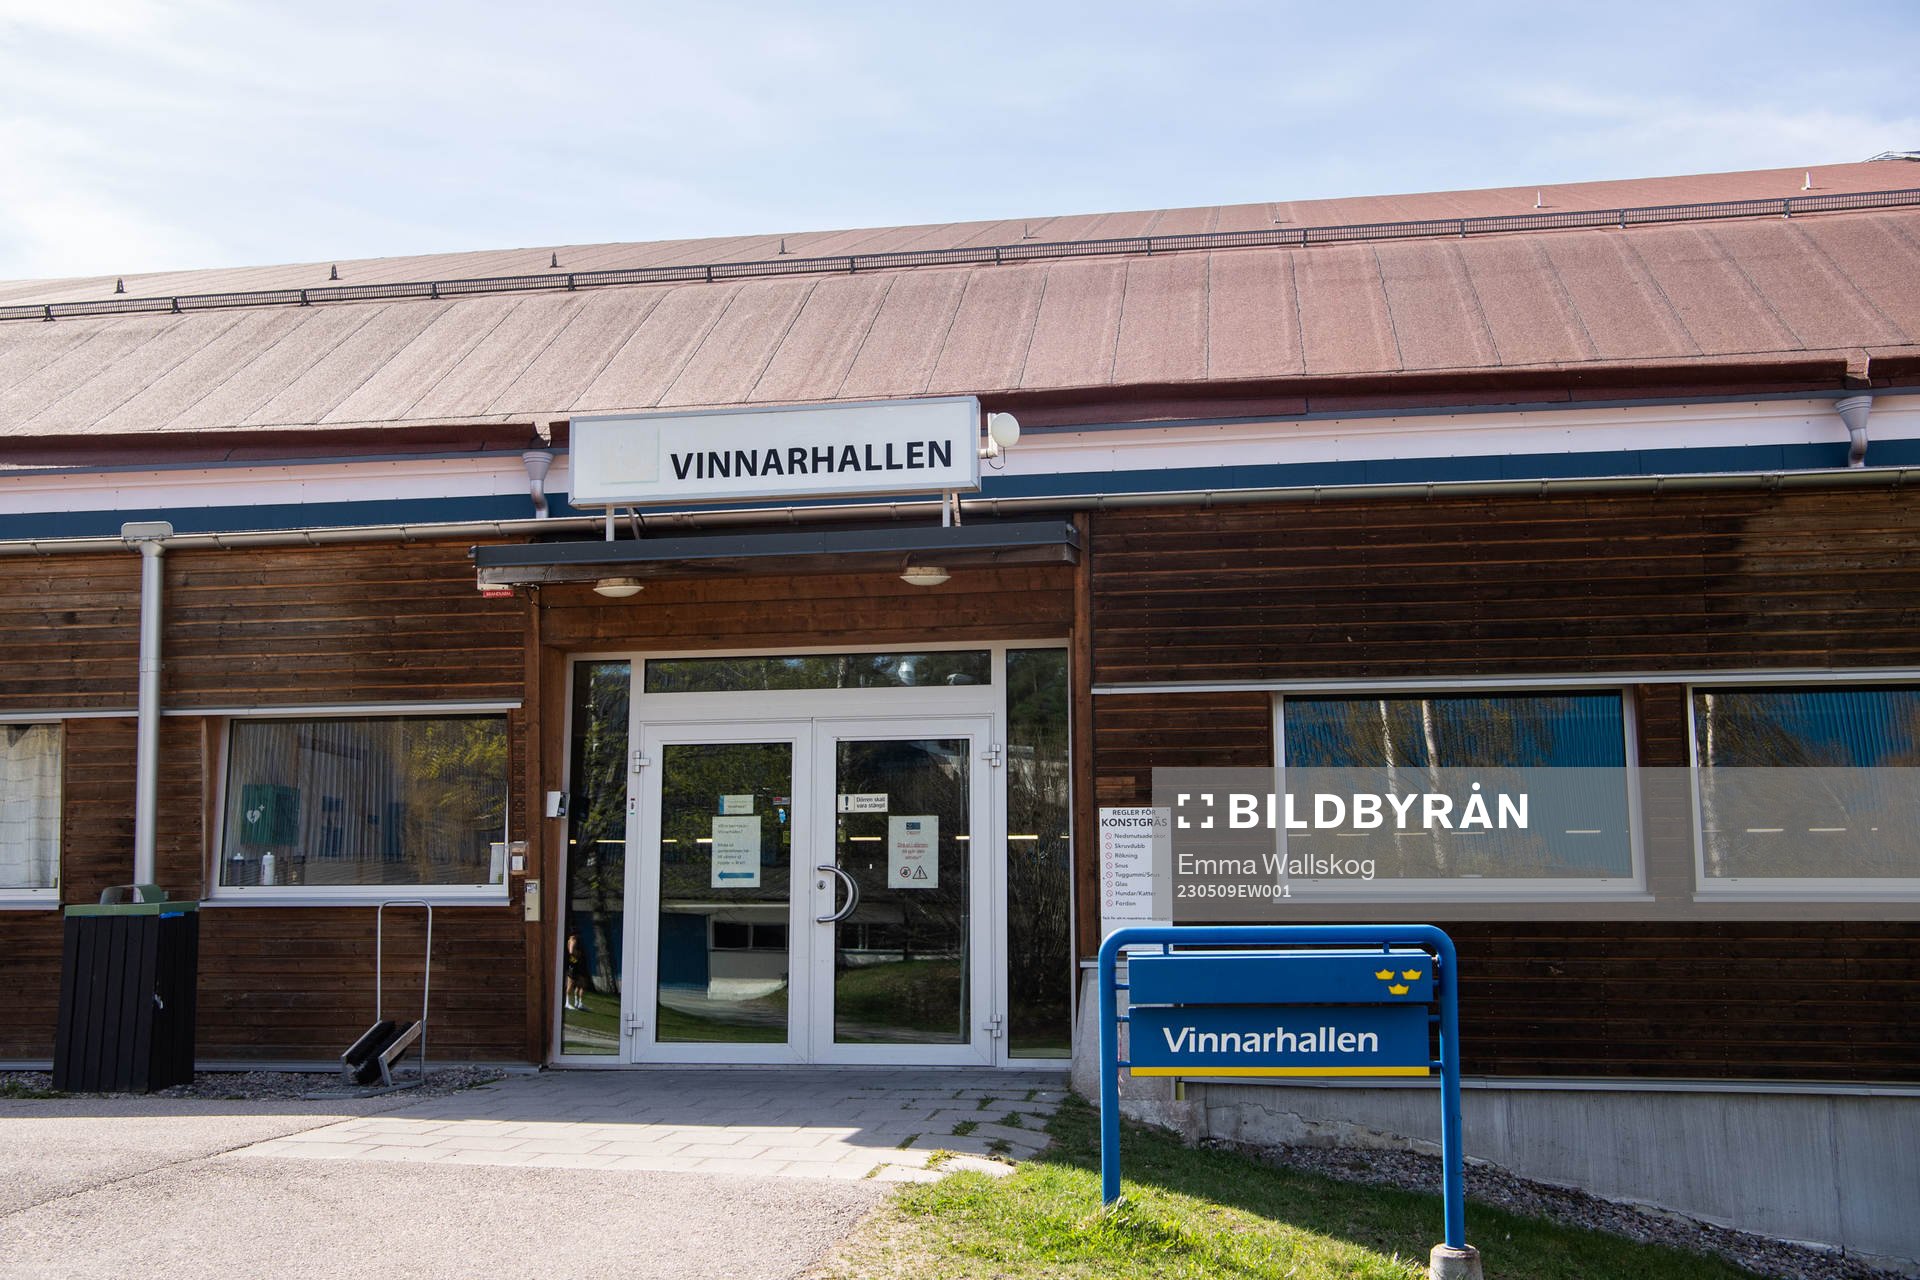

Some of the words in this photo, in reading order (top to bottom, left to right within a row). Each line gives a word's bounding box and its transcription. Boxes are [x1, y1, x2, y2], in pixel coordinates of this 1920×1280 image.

[670, 439, 952, 480] VINNARHALLEN
[1101, 816, 1168, 827] KONSTGRÄS
[1141, 808, 1156, 816] FÖR
[1162, 1026, 1379, 1053] Vinnarhallen
